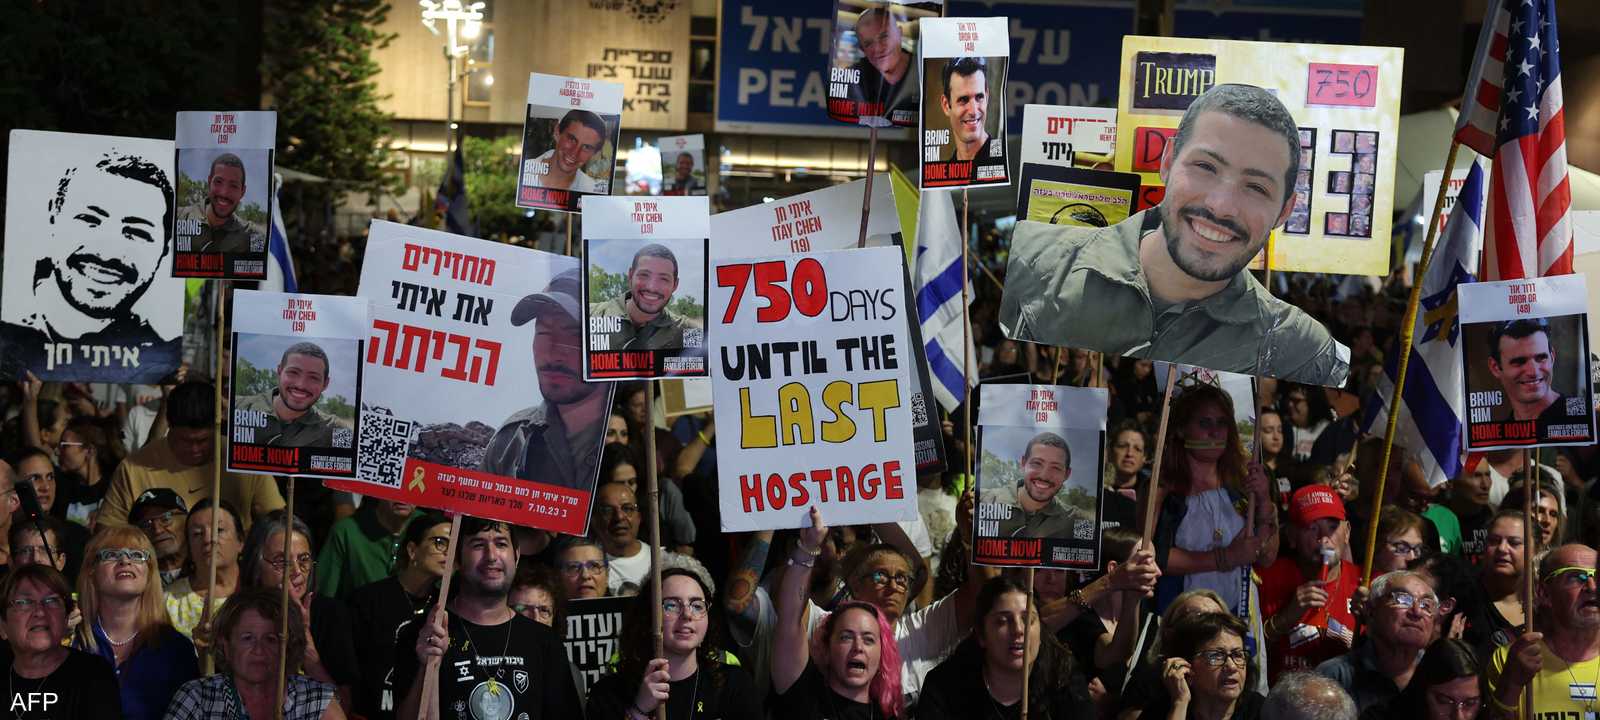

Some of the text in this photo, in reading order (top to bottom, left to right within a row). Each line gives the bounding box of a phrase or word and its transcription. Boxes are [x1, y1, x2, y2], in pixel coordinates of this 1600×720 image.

[1009, 17, 1071, 65] על
[830, 67, 861, 84] BRING
[1140, 62, 1214, 98] TRUMP
[1315, 70, 1372, 98] 750
[636, 82, 671, 97] בית
[829, 83, 849, 99] HIM
[829, 99, 856, 115] HOME
[210, 124, 237, 135] ITAY CHEN
[925, 129, 950, 146] BRING
[924, 146, 940, 162] HIM
[524, 159, 549, 175] BRING
[925, 160, 973, 180] HOME NOW!
[523, 173, 540, 186] HIM
[521, 187, 570, 204] HOME NOW!
[631, 213, 663, 223] ITAY CHEN
[775, 200, 813, 225] איתי חן
[176, 219, 201, 236] BRING
[771, 216, 823, 242] ITAY CHEN
[176, 236, 192, 252] HIM
[790, 237, 810, 253] (19)
[176, 253, 200, 271] HOME
[201, 253, 224, 271] NOW!
[402, 243, 497, 287] מחזירים
[716, 257, 897, 324] 750 DAYS
[1509, 283, 1536, 294] דרור אור
[297, 299, 313, 311] איתי
[391, 280, 494, 327] את איתי
[1509, 293, 1537, 305] DROR OR
[282, 309, 316, 321] ITAY CHEN
[1516, 303, 1531, 315] (48)
[292, 320, 306, 333] (19)
[590, 316, 622, 333] BRING
[590, 333, 610, 350] HIM
[44, 342, 140, 371] איתי חן
[366, 319, 502, 387] הביתה
[591, 350, 655, 370] HOME NOW!
[720, 334, 899, 381] UNTIL THE
[1026, 400, 1058, 411] ITAY CHEN
[1470, 390, 1503, 408] BRING
[234, 409, 268, 428] BRING
[739, 378, 901, 450] LAST
[1035, 411, 1048, 423] (19)
[1470, 407, 1491, 423] HIM
[233, 426, 255, 443] HIM
[1471, 419, 1537, 440] HOME NOW!
[233, 445, 299, 466] HOME NOW!
[739, 460, 904, 513] HOSTAGE
[528, 502, 560, 516] 7.10.23
[979, 502, 1012, 520] BRING
[978, 519, 999, 537] HIM
[977, 539, 1041, 558] HOME NOW!
[566, 612, 622, 640] ועדת
[475, 655, 503, 666] ישראל
